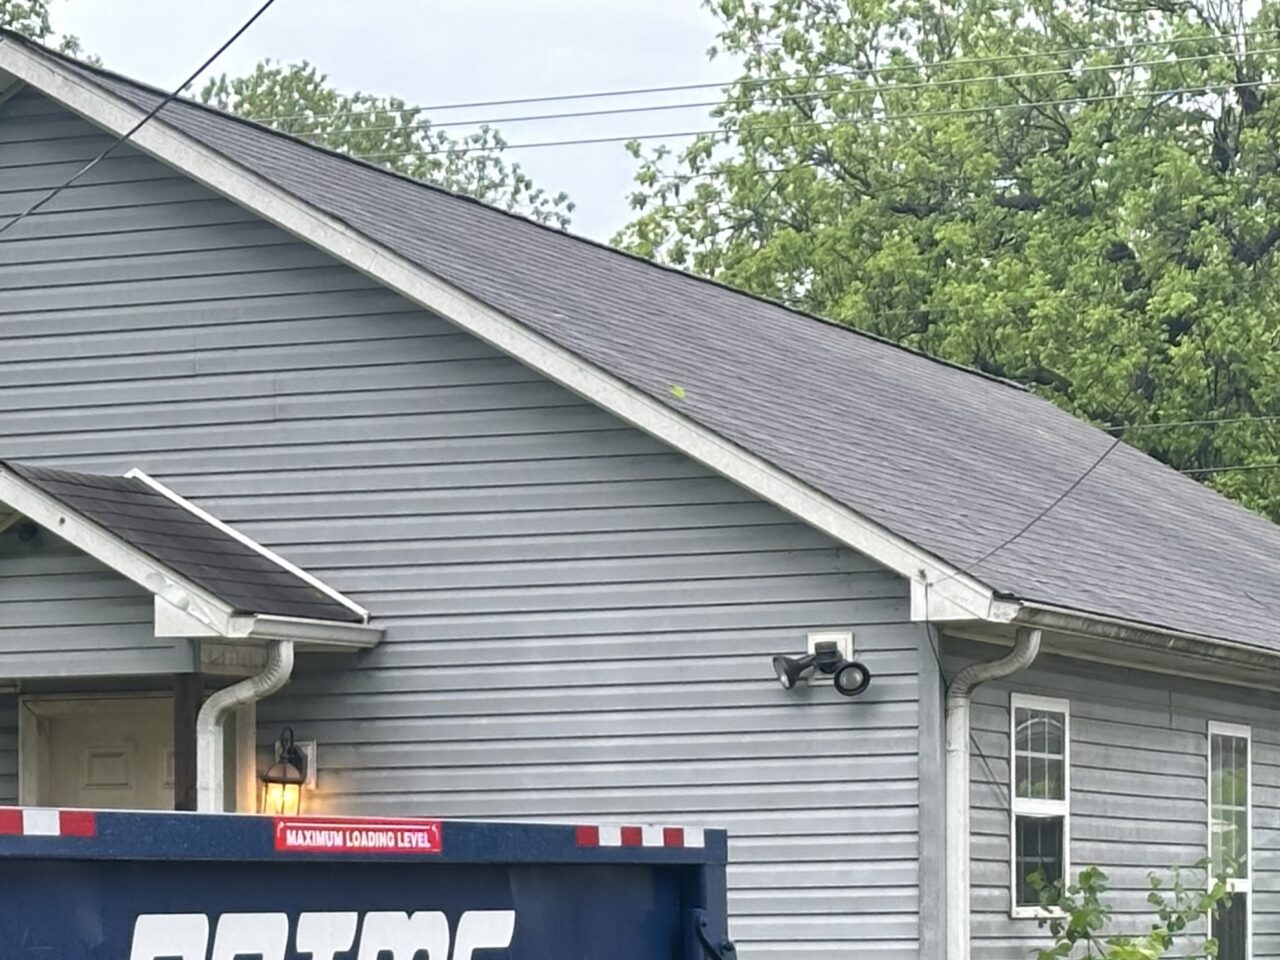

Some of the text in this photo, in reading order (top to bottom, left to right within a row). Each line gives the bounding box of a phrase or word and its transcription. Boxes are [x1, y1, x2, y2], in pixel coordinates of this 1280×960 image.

[286, 829, 431, 849] MAXIMUM LOADING LEVEL
